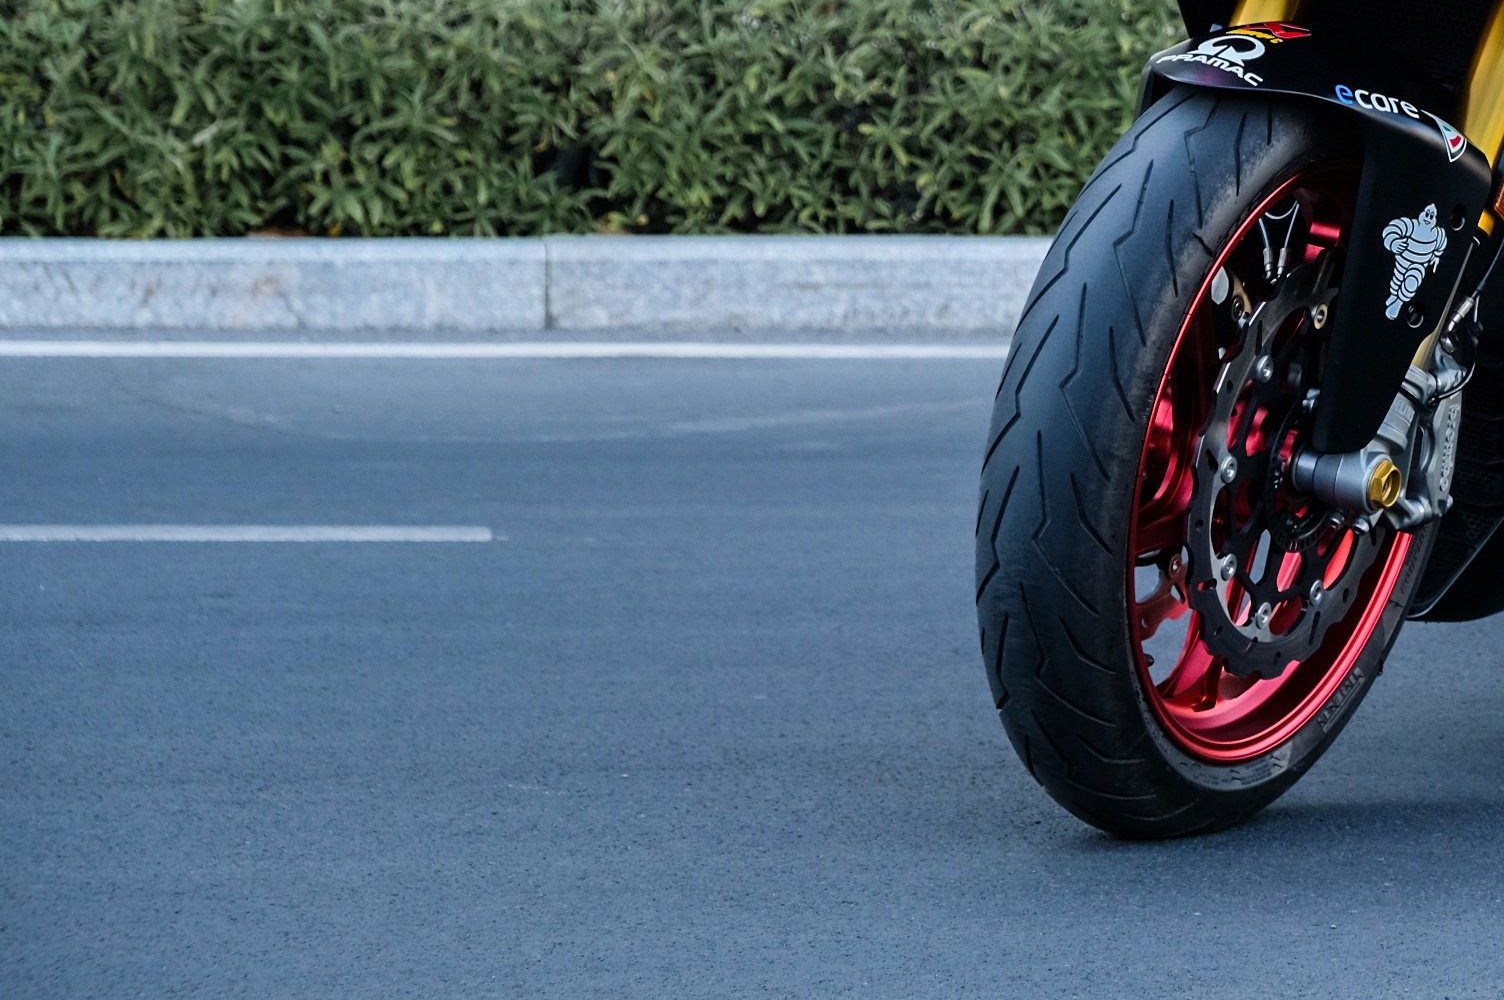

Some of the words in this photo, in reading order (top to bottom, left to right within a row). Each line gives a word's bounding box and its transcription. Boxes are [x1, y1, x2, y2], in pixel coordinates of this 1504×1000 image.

[1155, 54, 1264, 87] PRAMAC
[1334, 83, 1421, 120] ecare
[1438, 404, 1462, 492] brembo
